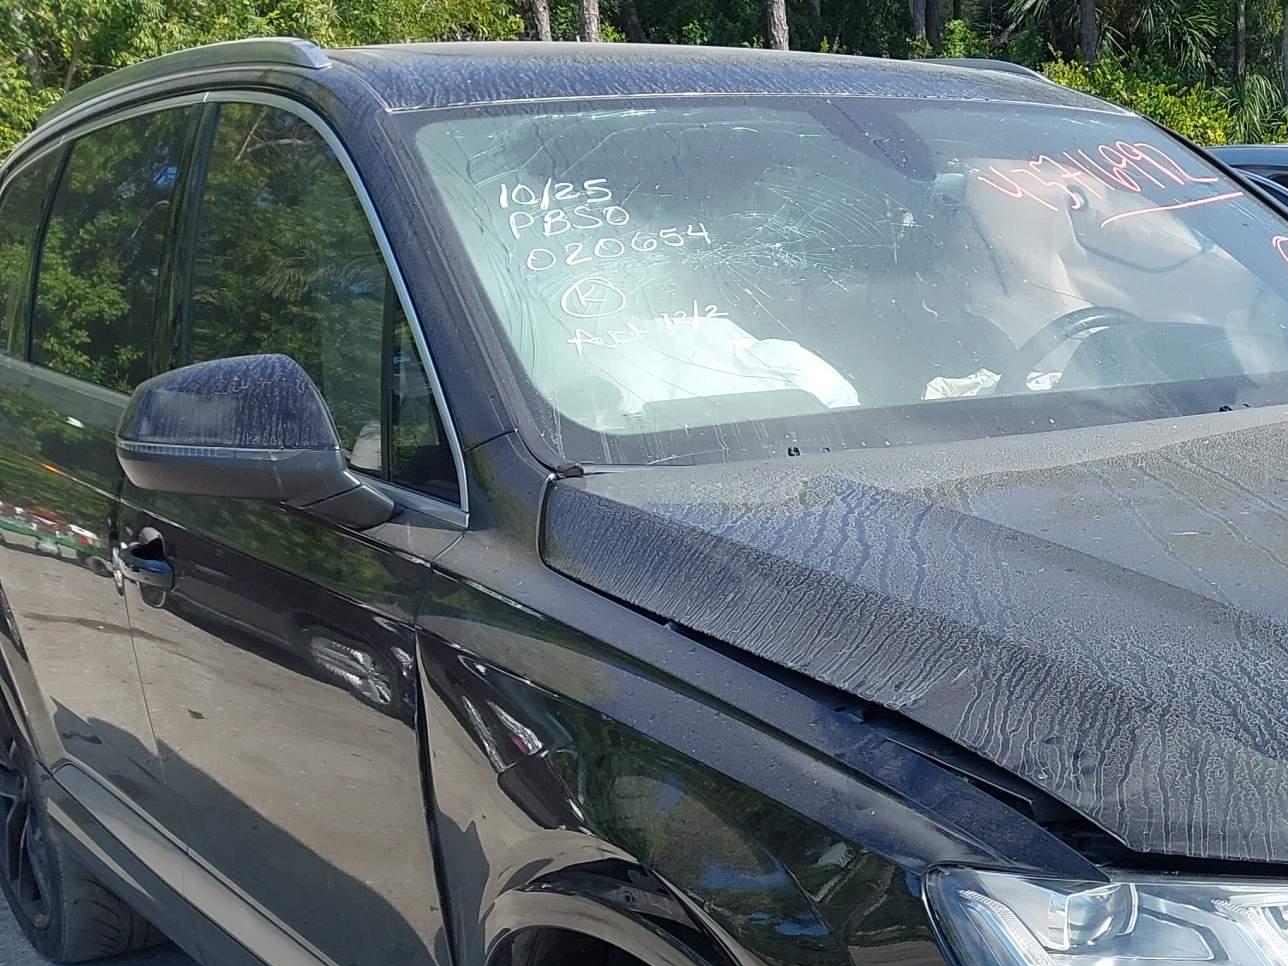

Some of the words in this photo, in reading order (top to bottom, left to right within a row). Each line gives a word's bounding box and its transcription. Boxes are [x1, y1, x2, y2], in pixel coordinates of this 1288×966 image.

[500, 178, 612, 210] 10/25
[509, 205, 630, 240] PBSO
[526, 222, 712, 271] 020654
